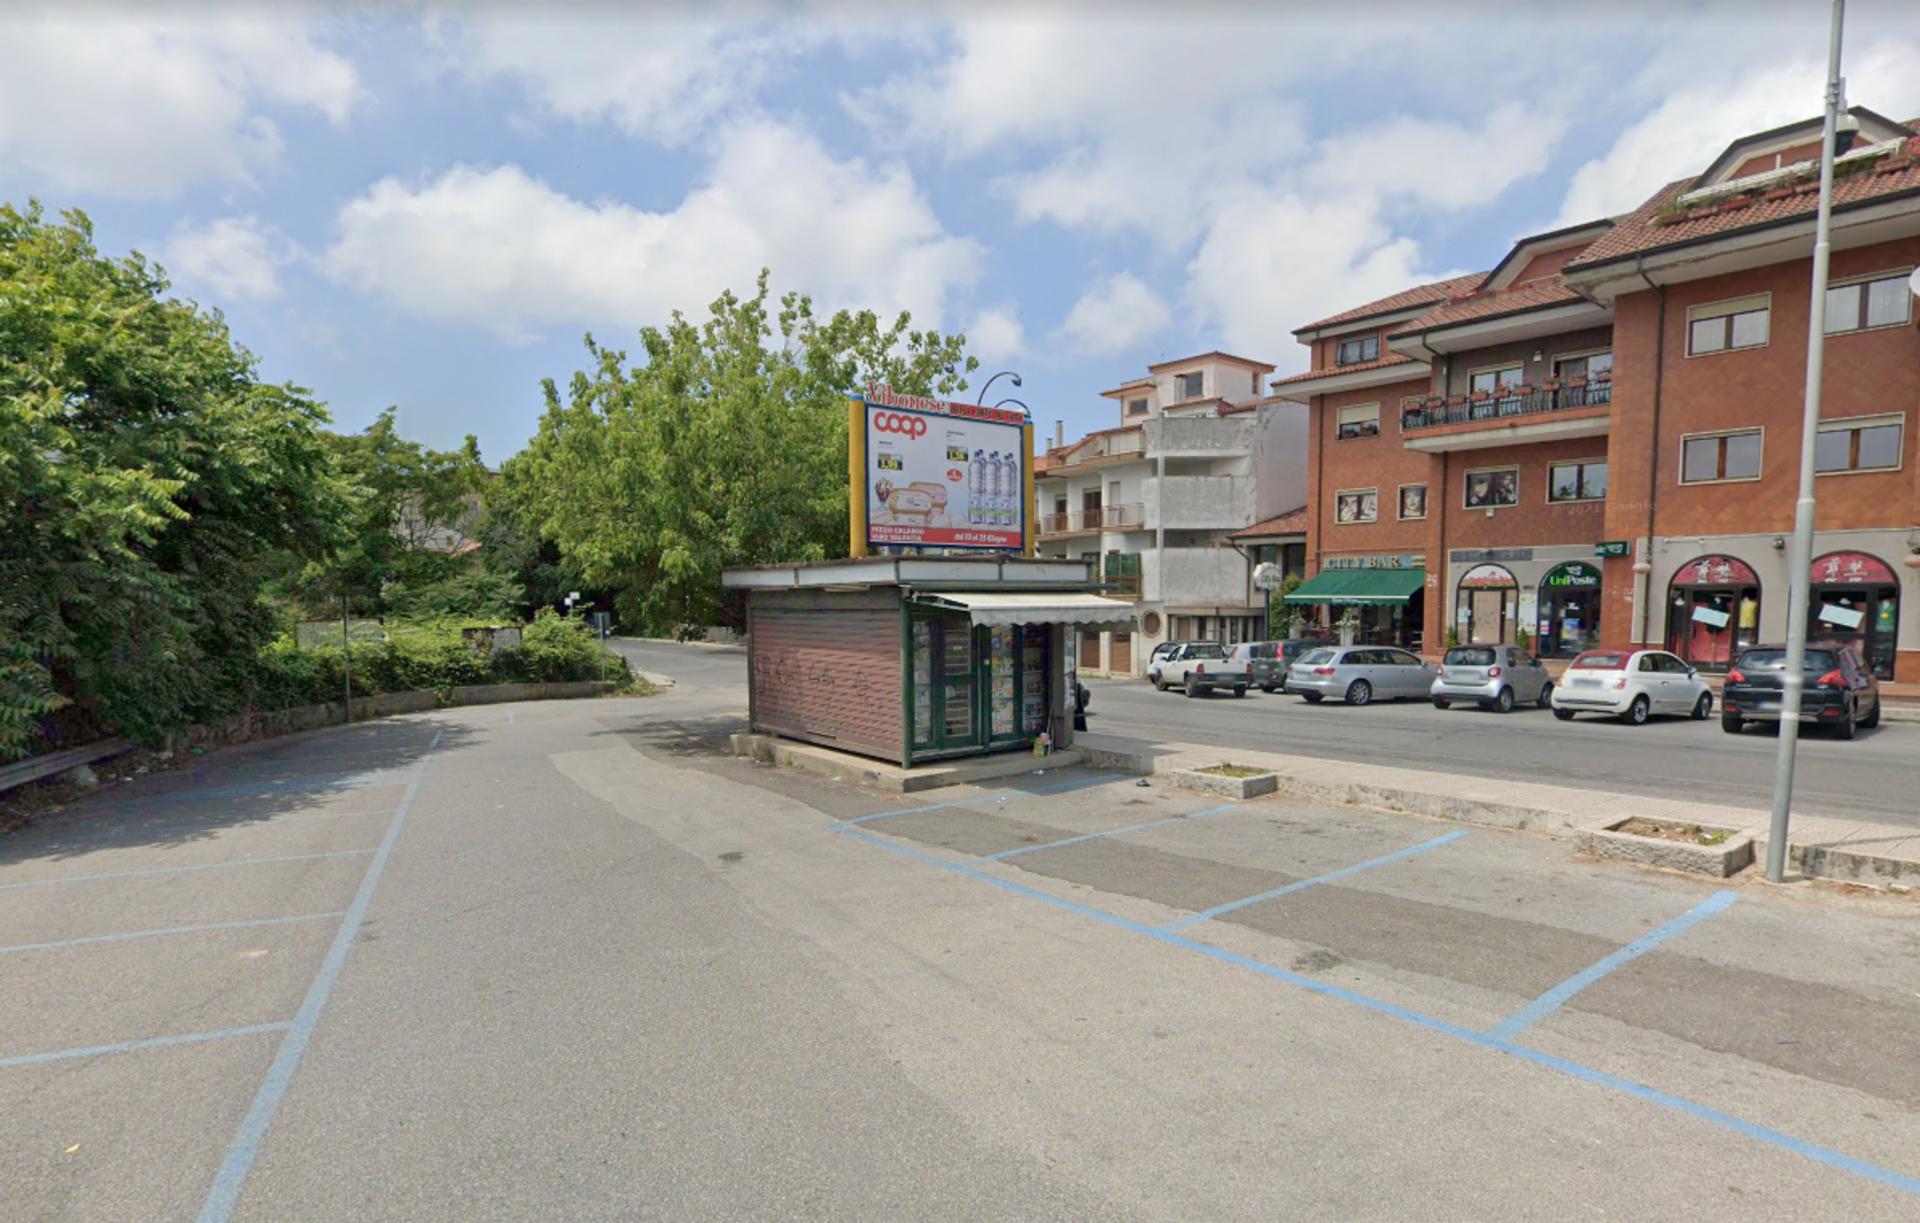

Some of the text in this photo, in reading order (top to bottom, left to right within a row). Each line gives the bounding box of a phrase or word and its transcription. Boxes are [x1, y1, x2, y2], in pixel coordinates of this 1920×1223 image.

[874, 411, 927, 440] coop
[1327, 556, 1400, 568] CITY BAR
[1550, 575, 1597, 586] UniPoste
